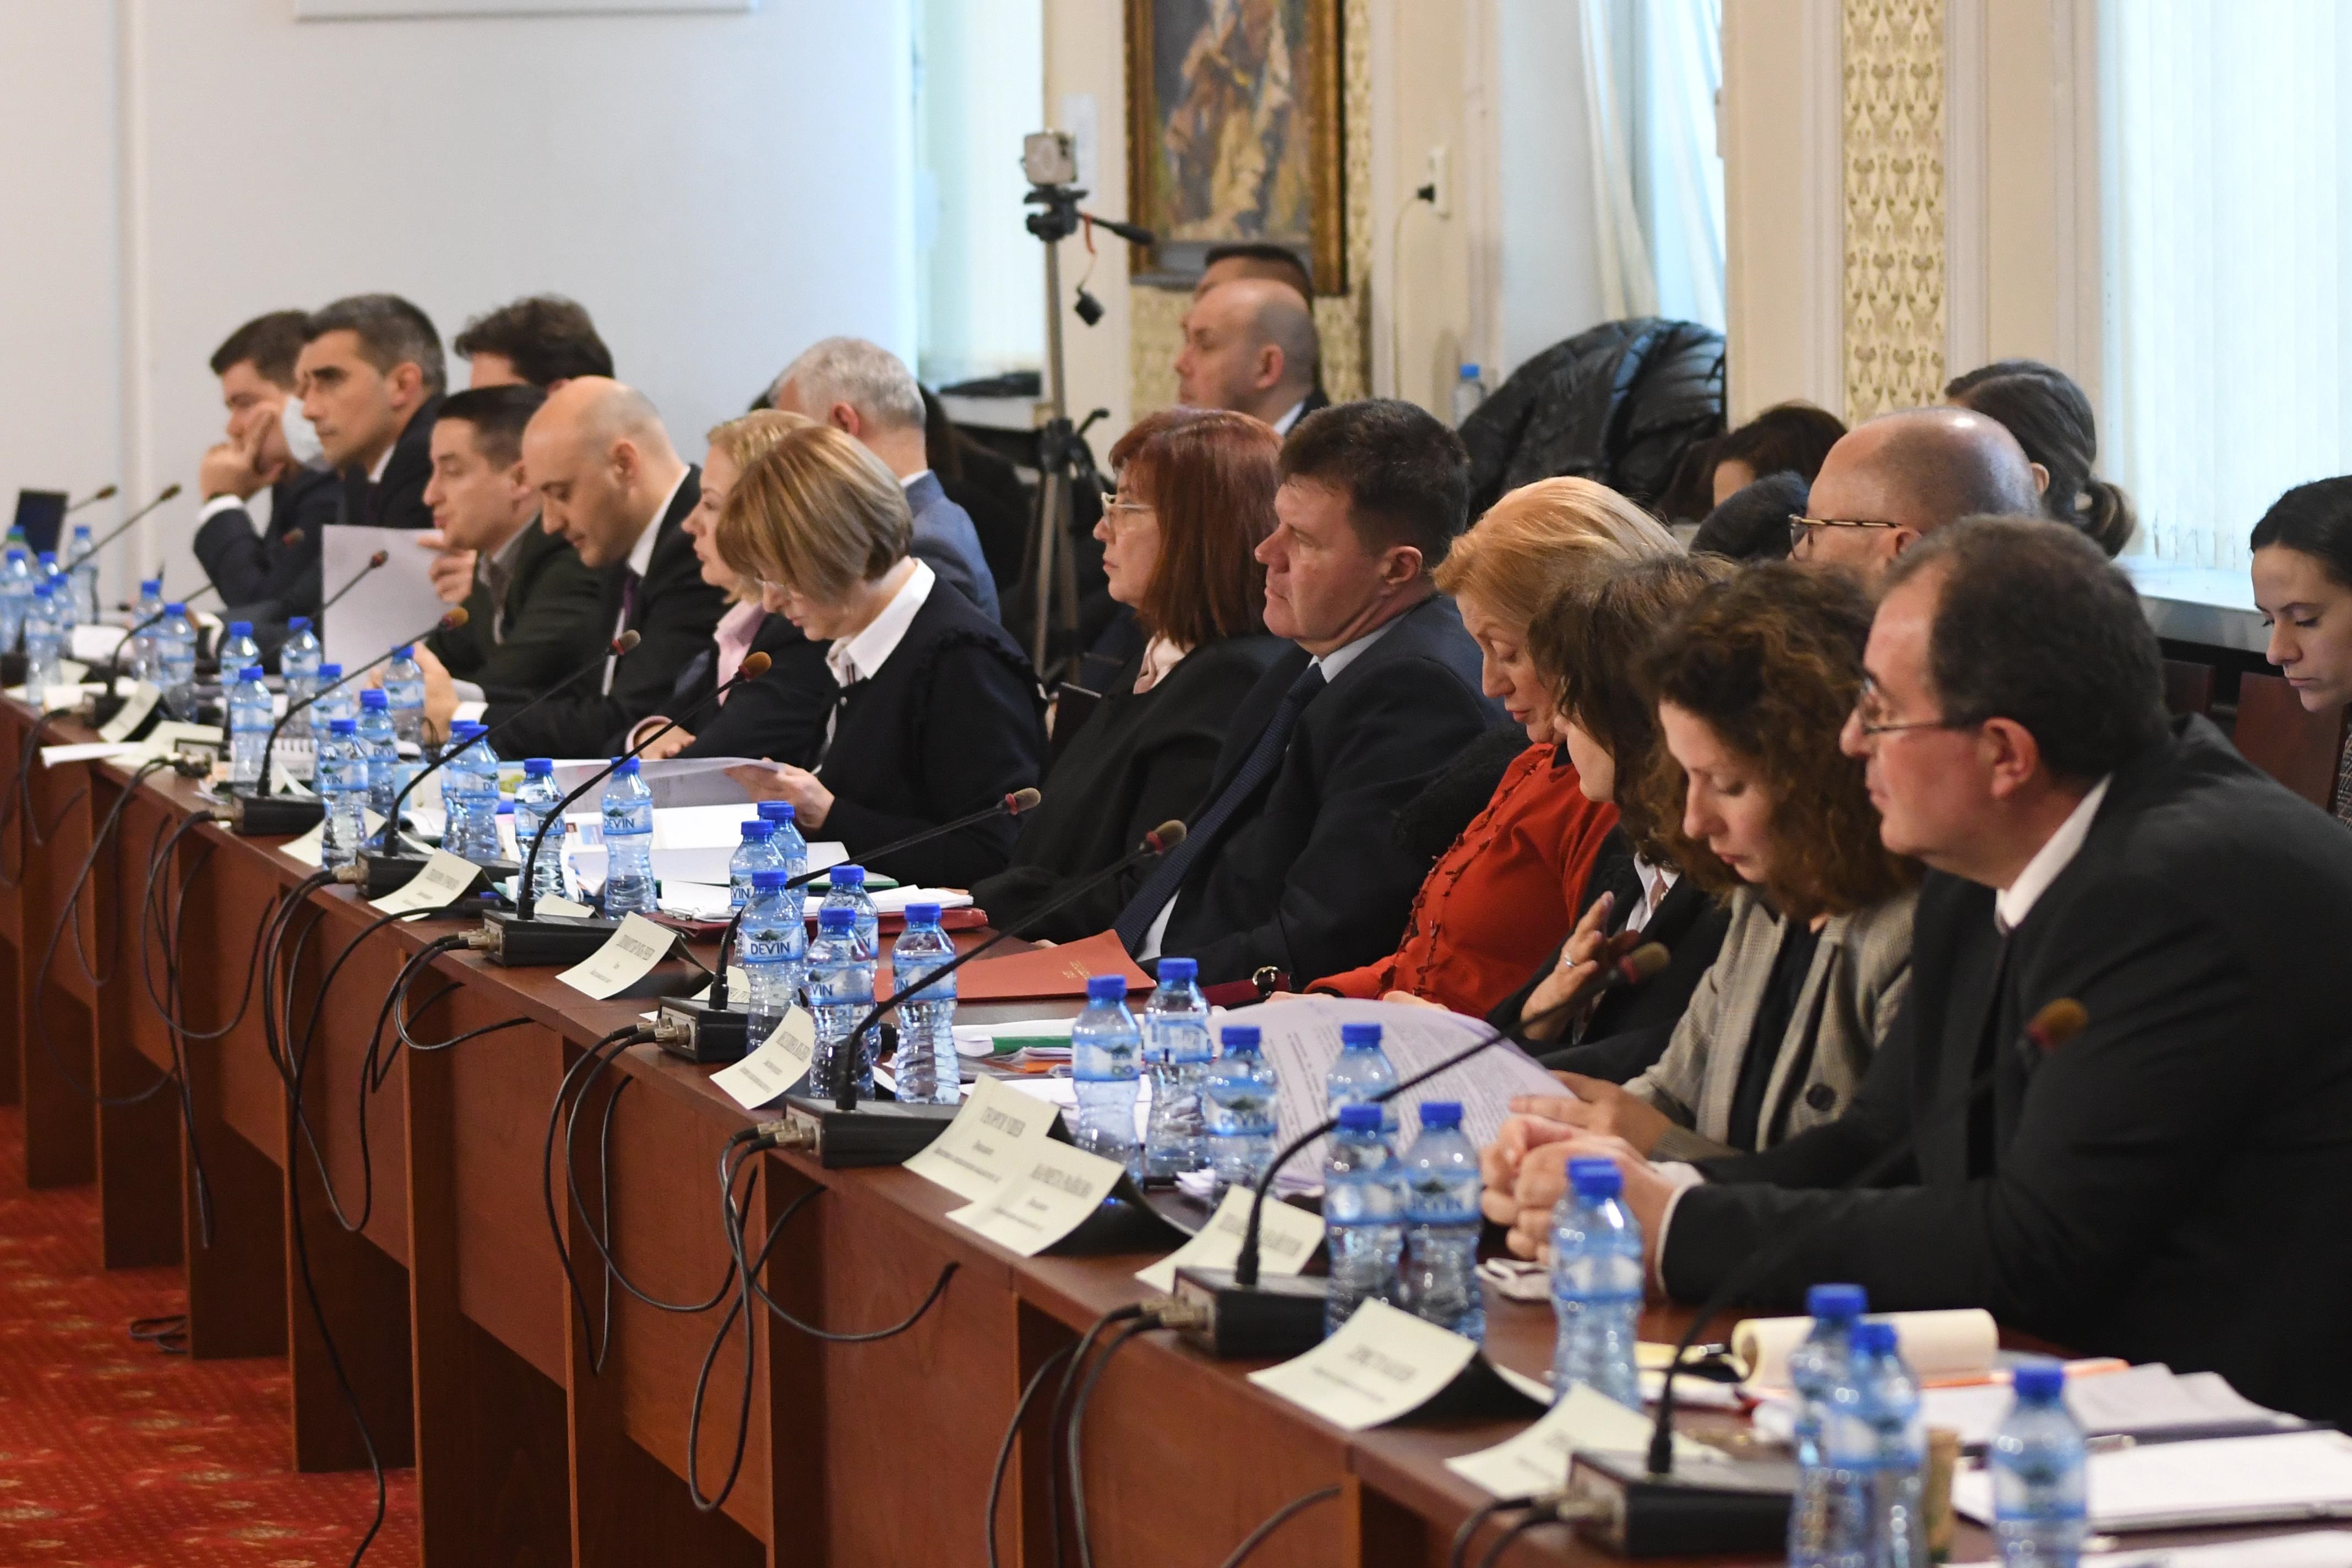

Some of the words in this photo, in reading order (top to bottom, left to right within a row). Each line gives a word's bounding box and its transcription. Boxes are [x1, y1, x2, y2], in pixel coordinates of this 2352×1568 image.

[324, 775, 342, 784] VIN
[605, 818, 634, 828] DEVIN
[732, 888, 750, 899] VIN
[750, 942, 791, 955] DEVIN
[811, 984, 833, 996] VIN
